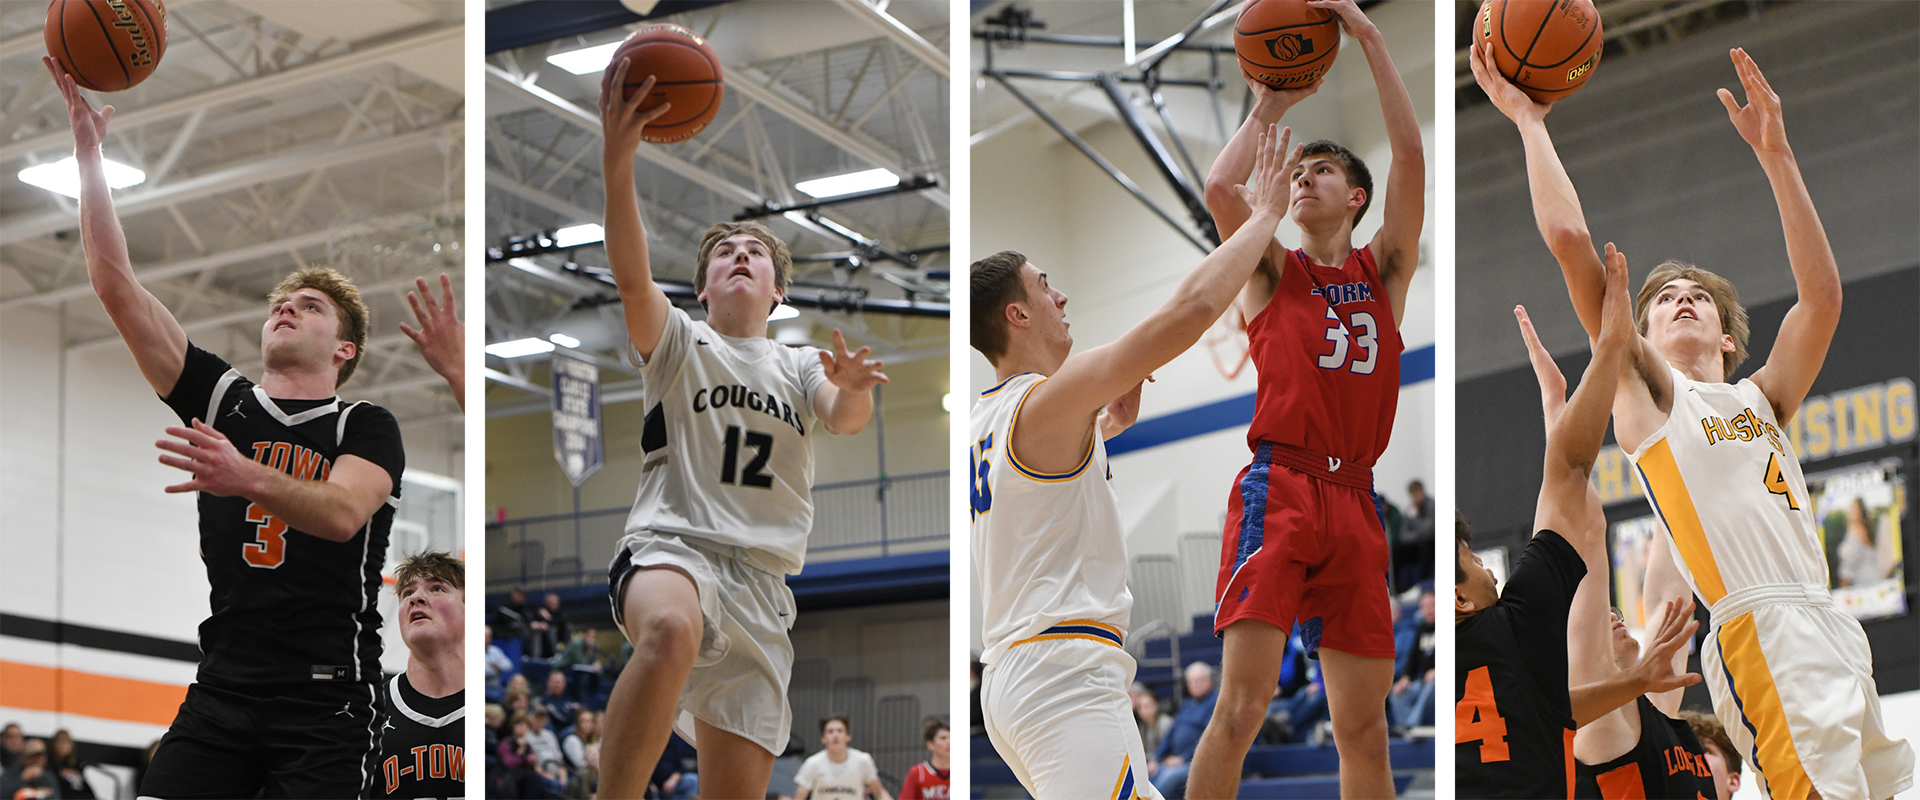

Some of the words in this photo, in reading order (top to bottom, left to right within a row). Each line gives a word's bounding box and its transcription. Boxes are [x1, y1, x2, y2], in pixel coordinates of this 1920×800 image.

[1317, 304, 1379, 375] 33
[693, 384, 805, 437] COUGARS
[719, 424, 775, 490] 12
[1763, 451, 1801, 511] 4
[241, 501, 289, 570] 3
[1455, 664, 1510, 763] 4
